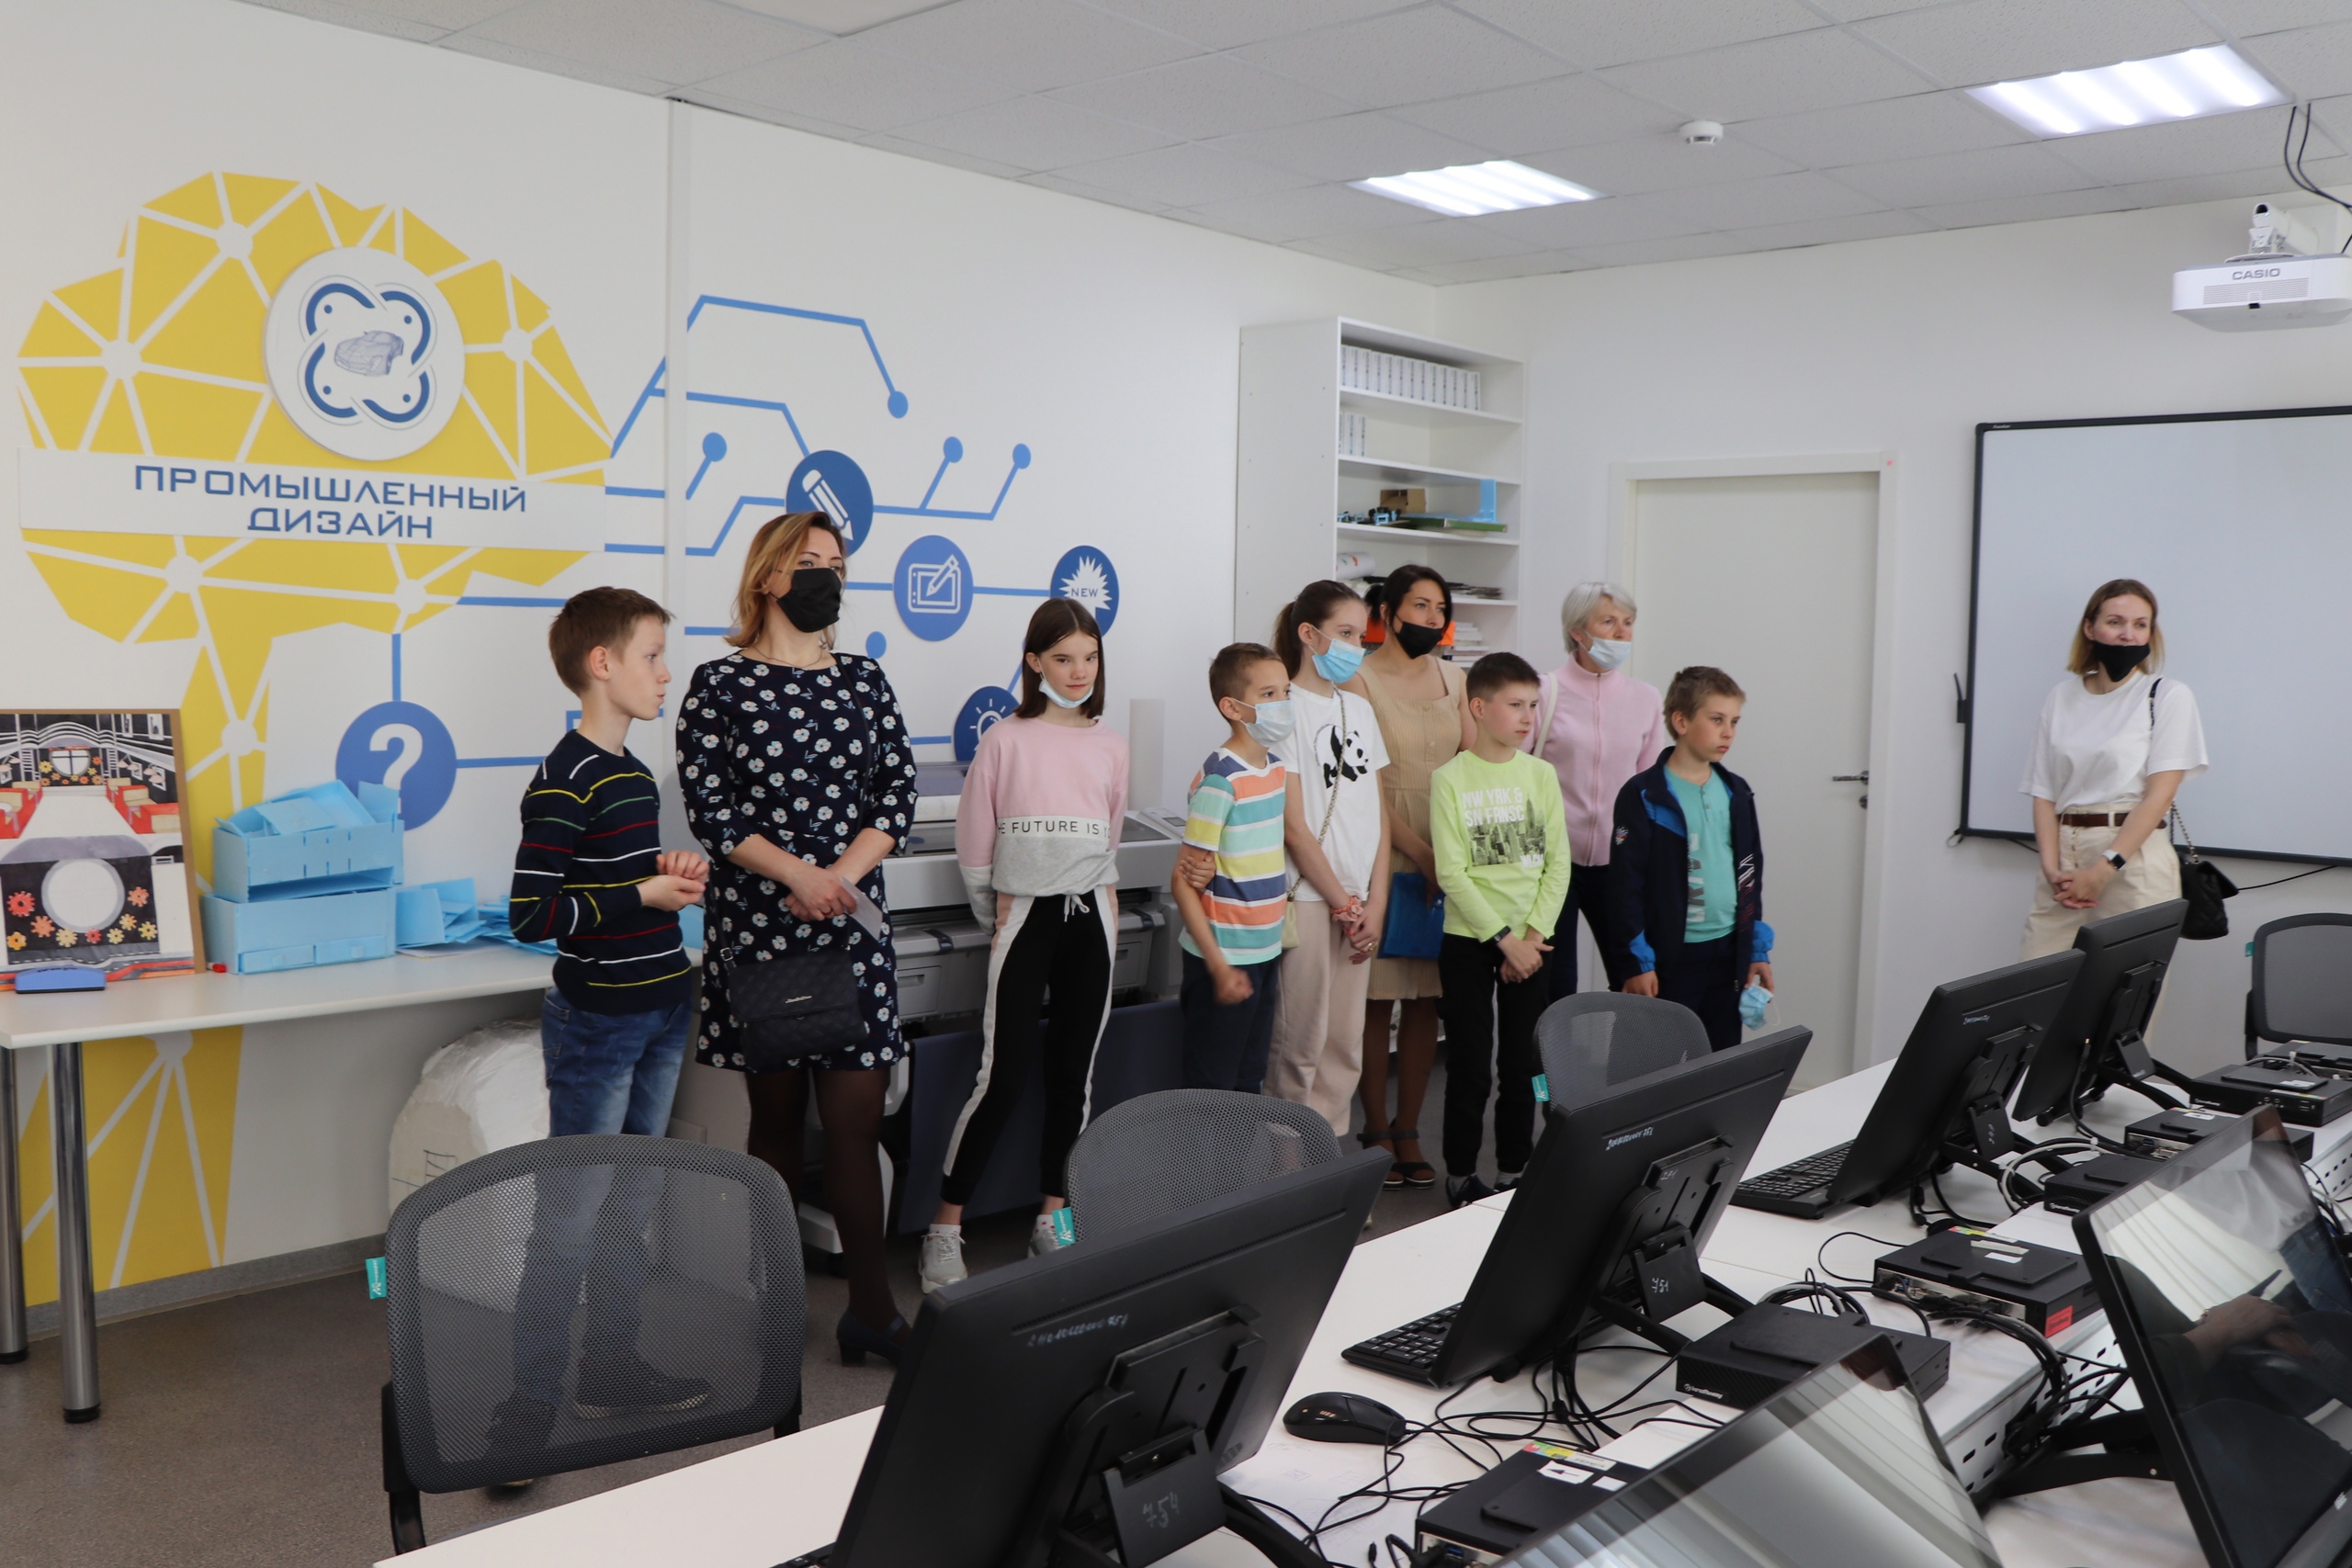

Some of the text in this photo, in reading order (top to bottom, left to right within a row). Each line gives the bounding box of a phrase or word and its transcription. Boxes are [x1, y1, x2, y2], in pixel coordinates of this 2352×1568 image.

[2232, 267, 2281, 281] CASIO
[135, 465, 526, 512] ПРОМЫШЛЕННЫЙ
[247, 507, 432, 538] ДИЗАЙН
[1070, 587, 1099, 598] NEW
[1463, 790, 1484, 809] NW
[1487, 787, 1511, 807] YRK
[1465, 805, 1525, 827] SN FRNSC
[1012, 820, 1079, 834] FUTURE
[1087, 822, 1100, 835] IS
